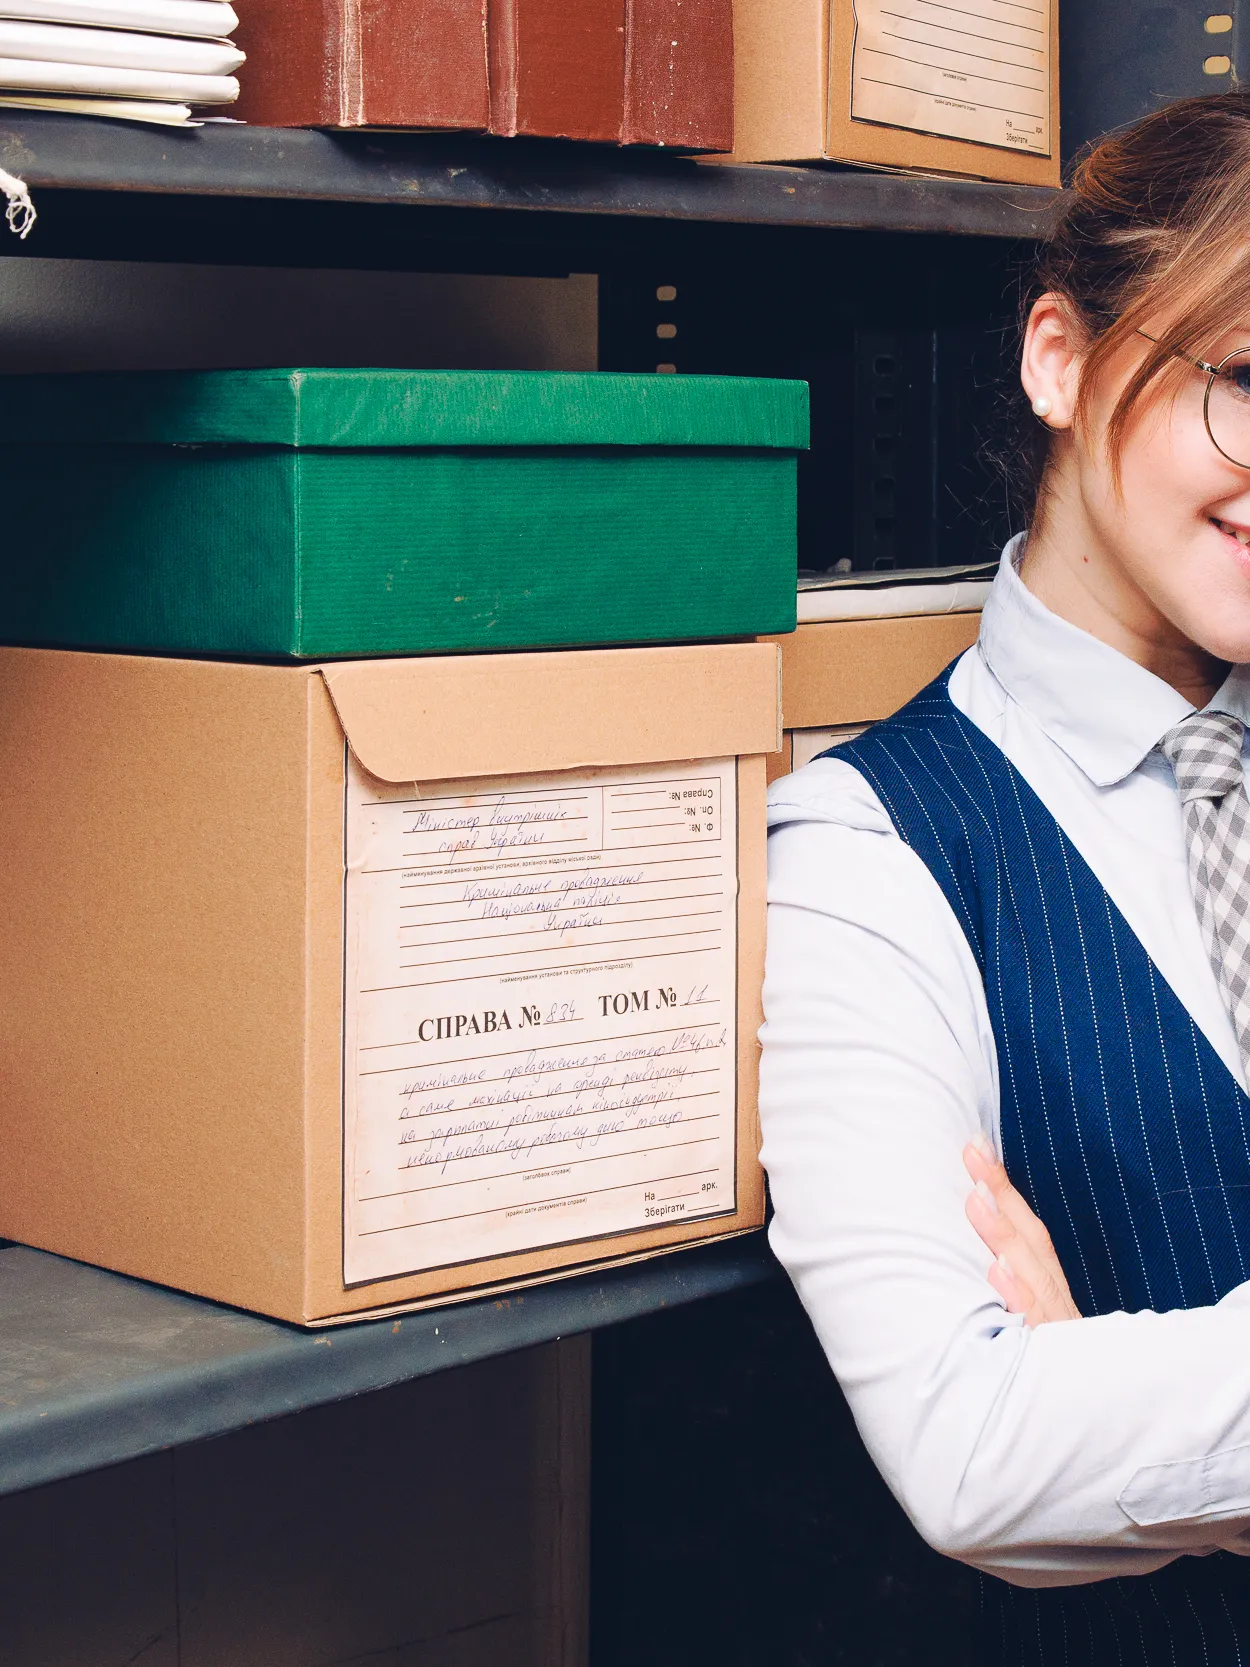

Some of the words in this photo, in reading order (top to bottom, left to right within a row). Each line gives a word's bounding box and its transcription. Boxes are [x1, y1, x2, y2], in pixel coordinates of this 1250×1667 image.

[683, 788, 713, 798] Справа
[700, 806, 713, 815] Оп.
[704, 823, 713, 831] Ф.
[543, 912, 603, 937] України
[539, 971, 562, 979] установи
[570, 966, 603, 975] структурного
[418, 1009, 513, 1041] СПРАВА
[518, 1005, 541, 1028] №
[545, 999, 576, 1023] 834
[598, 990, 649, 1017] ТОМ
[655, 987, 677, 1010] №
[419, 1100, 455, 1116] саме
[644, 1192, 655, 1201] На
[702, 1180, 718, 1192] арк.
[644, 1203, 686, 1218] Зберігати
